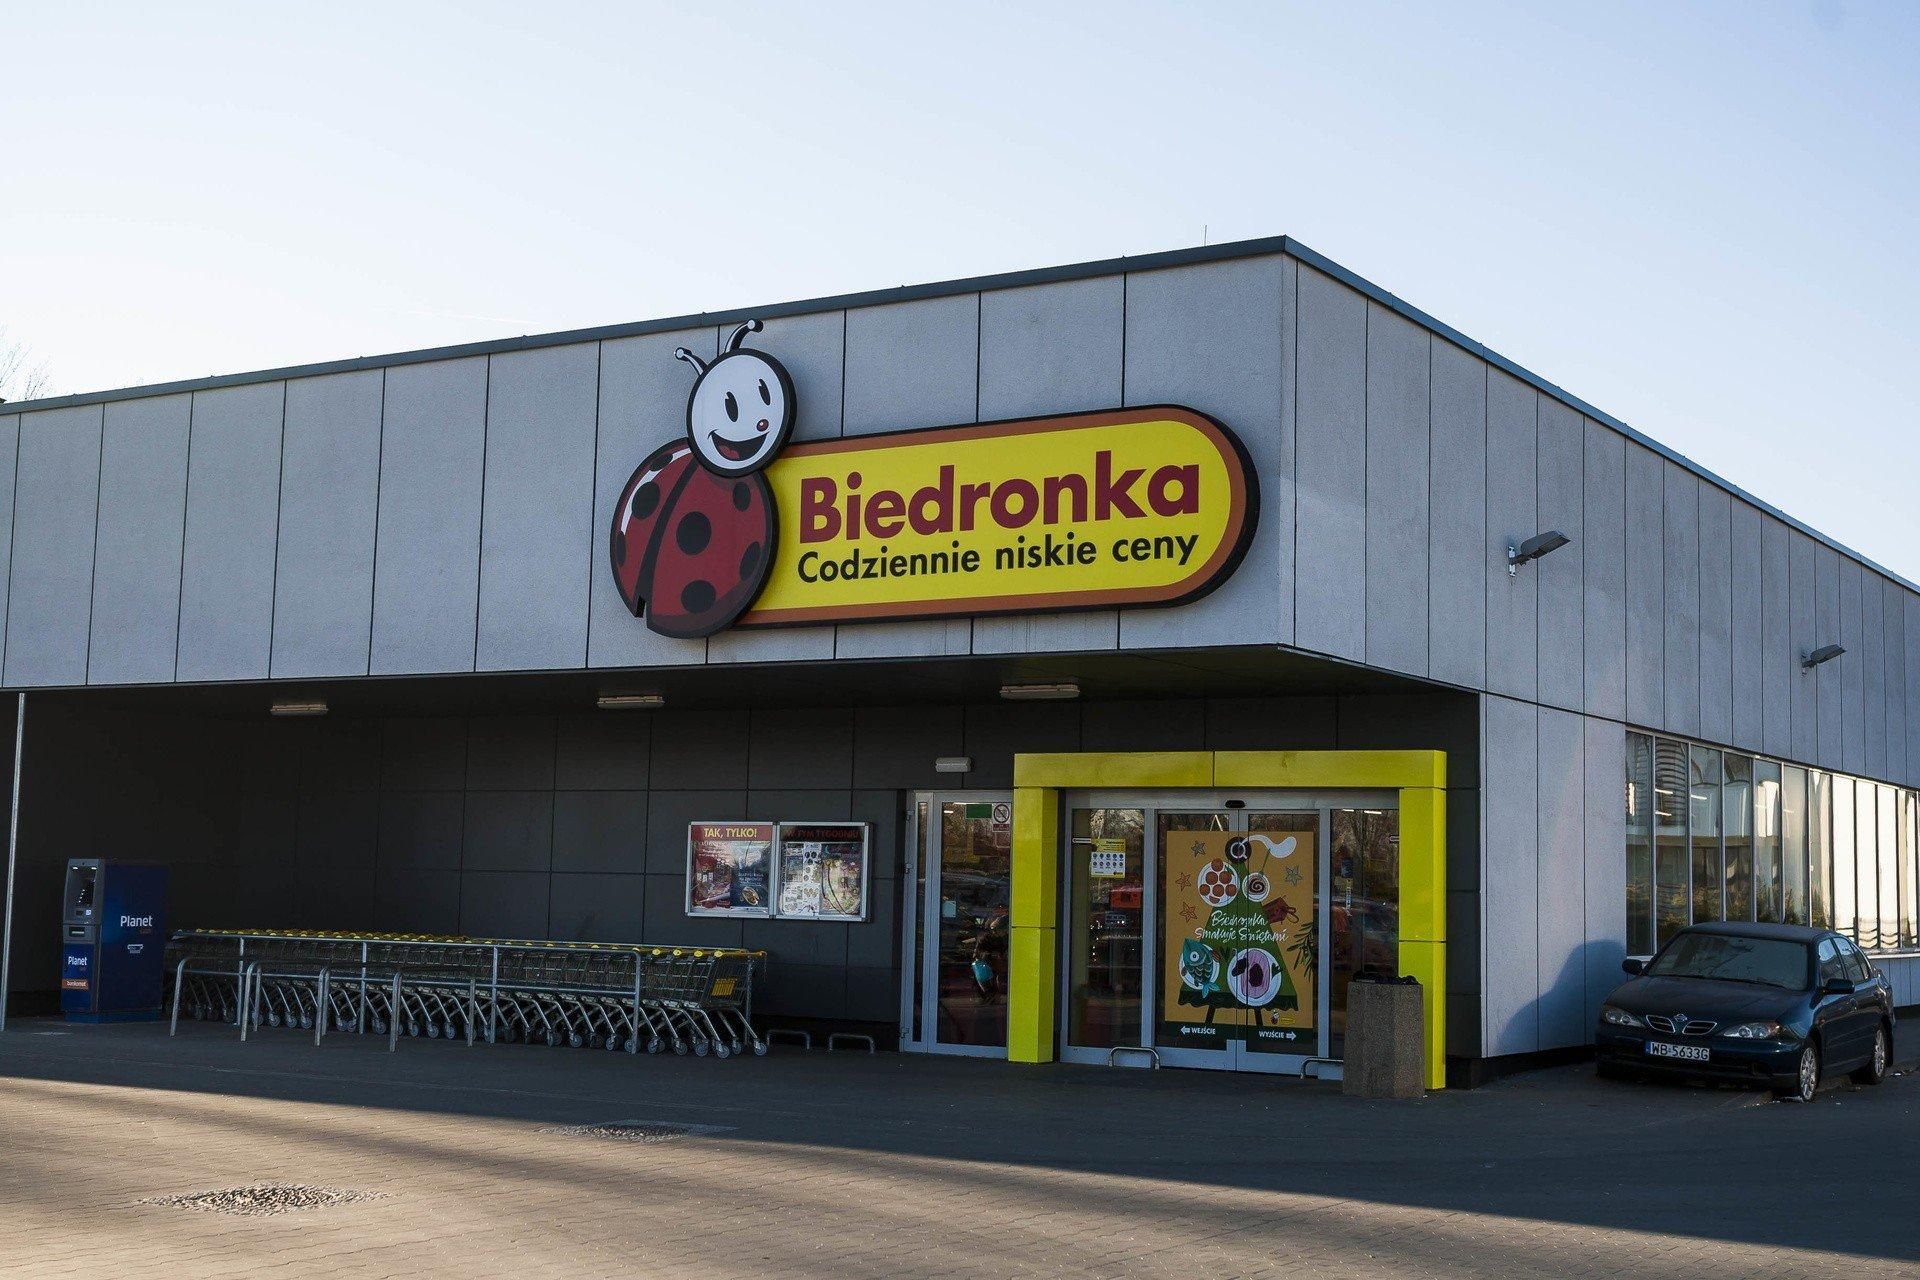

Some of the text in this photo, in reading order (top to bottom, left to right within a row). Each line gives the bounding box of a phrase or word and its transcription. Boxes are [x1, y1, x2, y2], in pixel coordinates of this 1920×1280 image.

[799, 450, 1200, 544] Biedronka
[798, 529, 1199, 583] Codziennie niskie ceny
[704, 828, 757, 838] TAK, TYLKO!
[120, 915, 153, 927] Planet
[67, 956, 88, 966] Planet
[1191, 1027, 1216, 1035] WEJŚCIE
[1259, 1030, 1285, 1039] WYJŚCIE
